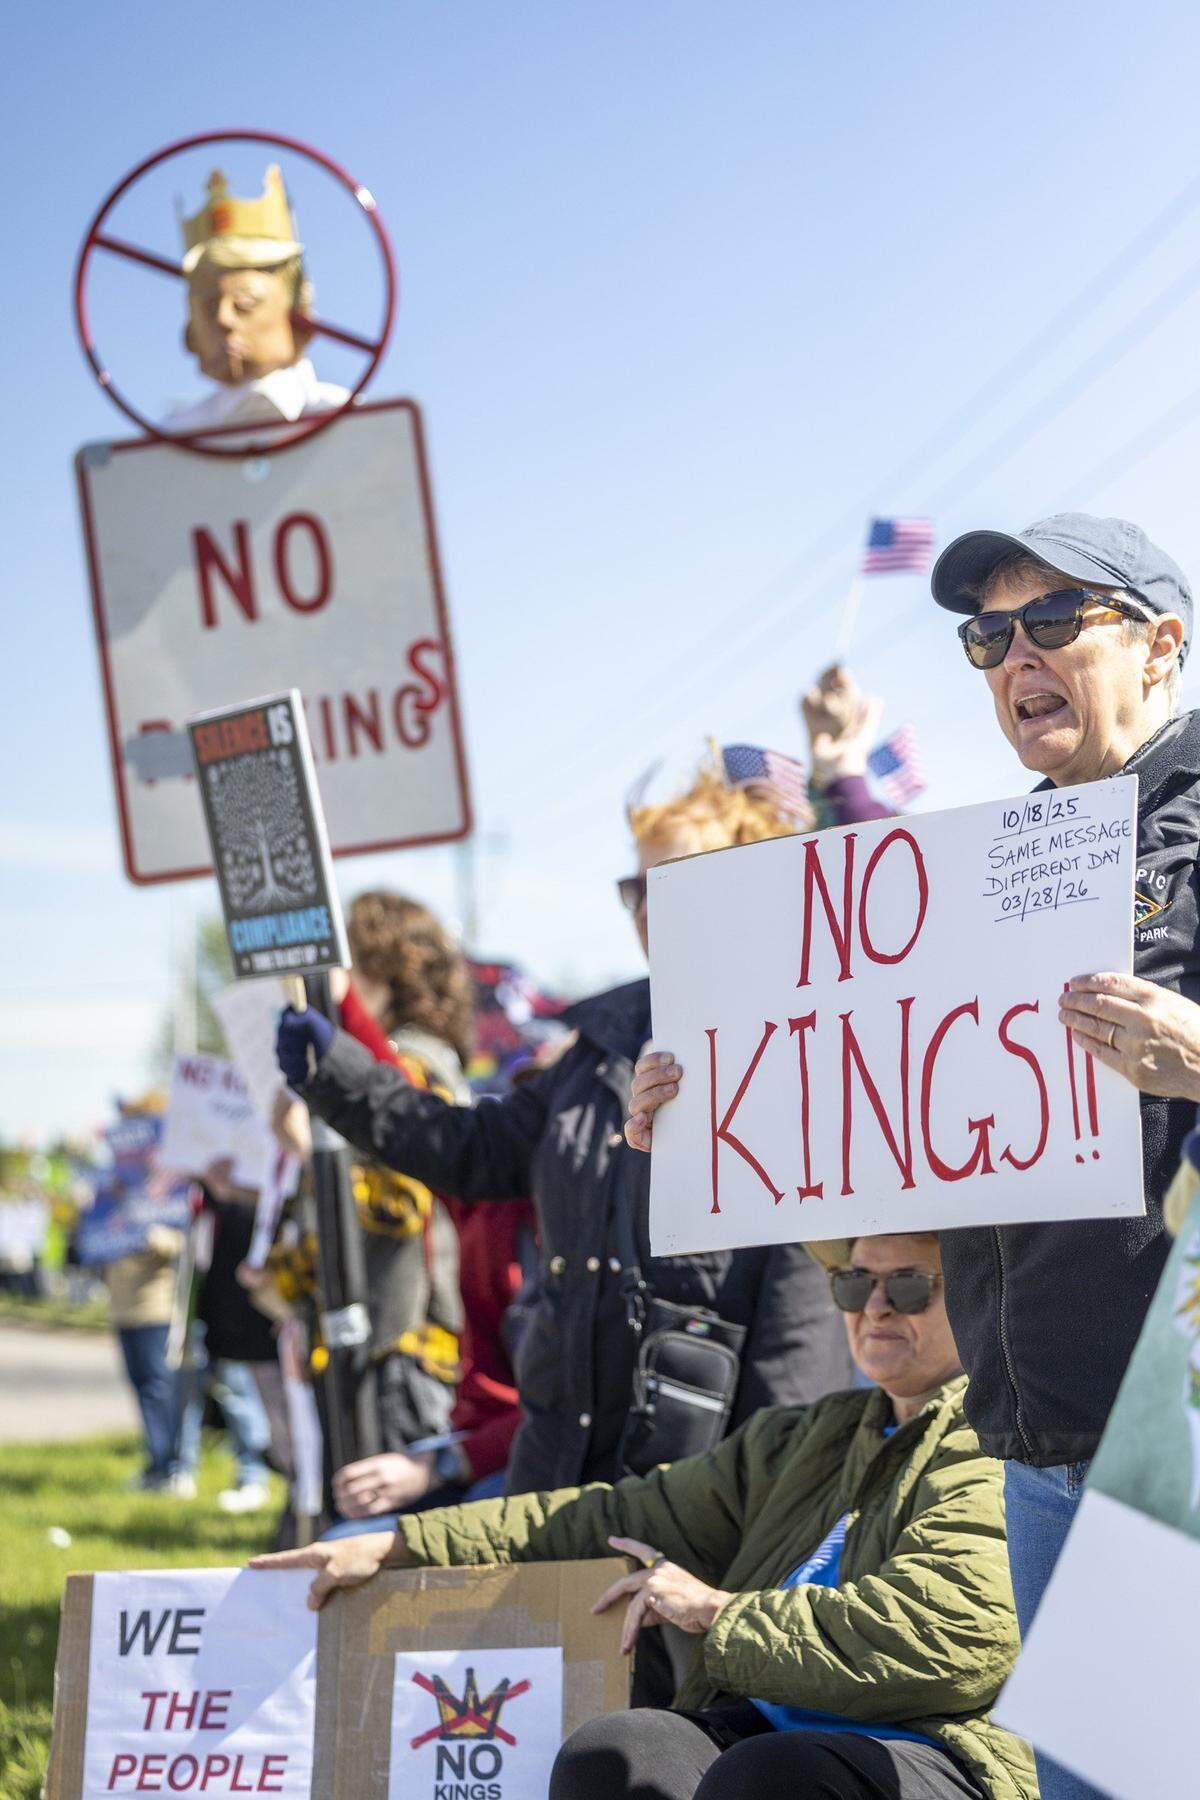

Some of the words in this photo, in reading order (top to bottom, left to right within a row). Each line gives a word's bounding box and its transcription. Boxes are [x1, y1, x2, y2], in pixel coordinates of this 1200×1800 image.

[193, 511, 333, 629] NO
[303, 637, 443, 762] INGS
[267, 704, 294, 746] IS
[1003, 794, 1079, 834] 10/18/25
[988, 838, 1043, 868] SAME
[1049, 819, 1131, 852] MESSAGE
[983, 856, 1081, 896] DIFFERENT
[1087, 846, 1121, 869] DAY
[1136, 868, 1166, 890] PIC
[796, 828, 929, 988] NO
[1002, 878, 1088, 921] 03/28/26
[1140, 926, 1168, 942] PARK
[705, 982, 1100, 1214] KINGS!!
[118, 1608, 206, 1656] WE
[141, 1690, 231, 1731] THE
[107, 1754, 288, 1792] PEOPLE
[435, 1743, 503, 1781] NO
[434, 1783, 503, 1800] KINGS
